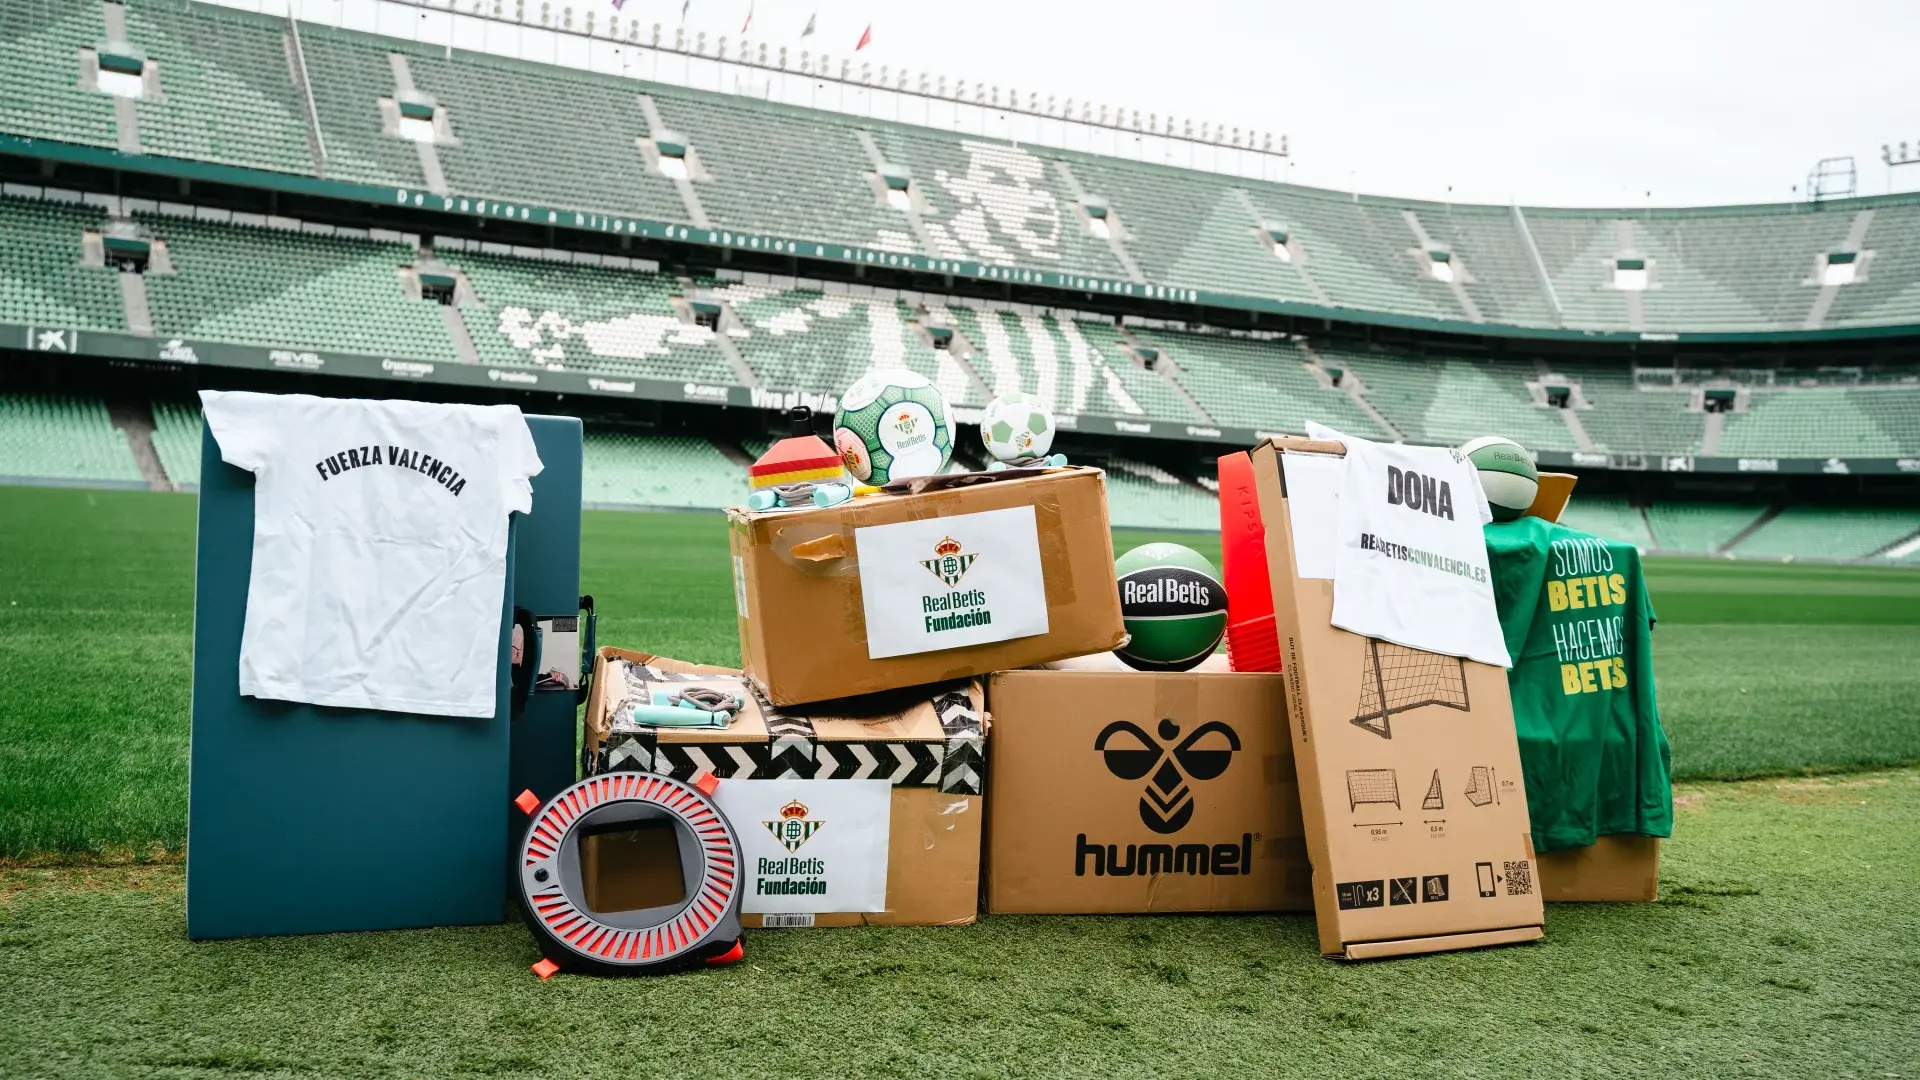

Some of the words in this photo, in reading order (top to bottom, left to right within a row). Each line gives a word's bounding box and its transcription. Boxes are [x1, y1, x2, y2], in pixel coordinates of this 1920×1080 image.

[397, 189, 424, 205] De
[444, 194, 530, 220] padres
[549, 211, 557, 222] a
[665, 224, 688, 239] de
[816, 245, 824, 256] a
[897, 435, 911, 450] Real
[911, 433, 927, 447] Betis
[315, 445, 383, 481] FUERZA
[388, 445, 467, 497] VALENCIA
[1387, 464, 1455, 522] DONA
[1551, 537, 1613, 577] SOMOS
[922, 592, 953, 613] Real
[953, 588, 986, 609] Betis
[1124, 578, 1163, 605] Real
[1165, 578, 1210, 606] Betis
[1547, 573, 1627, 612] BETIS
[925, 607, 991, 634] Fundación
[757, 857, 788, 875] Real
[790, 857, 825, 875] Betis
[1075, 832, 1253, 877] hummel
[756, 877, 827, 895] Fundación
[1366, 887, 1380, 902] x3
